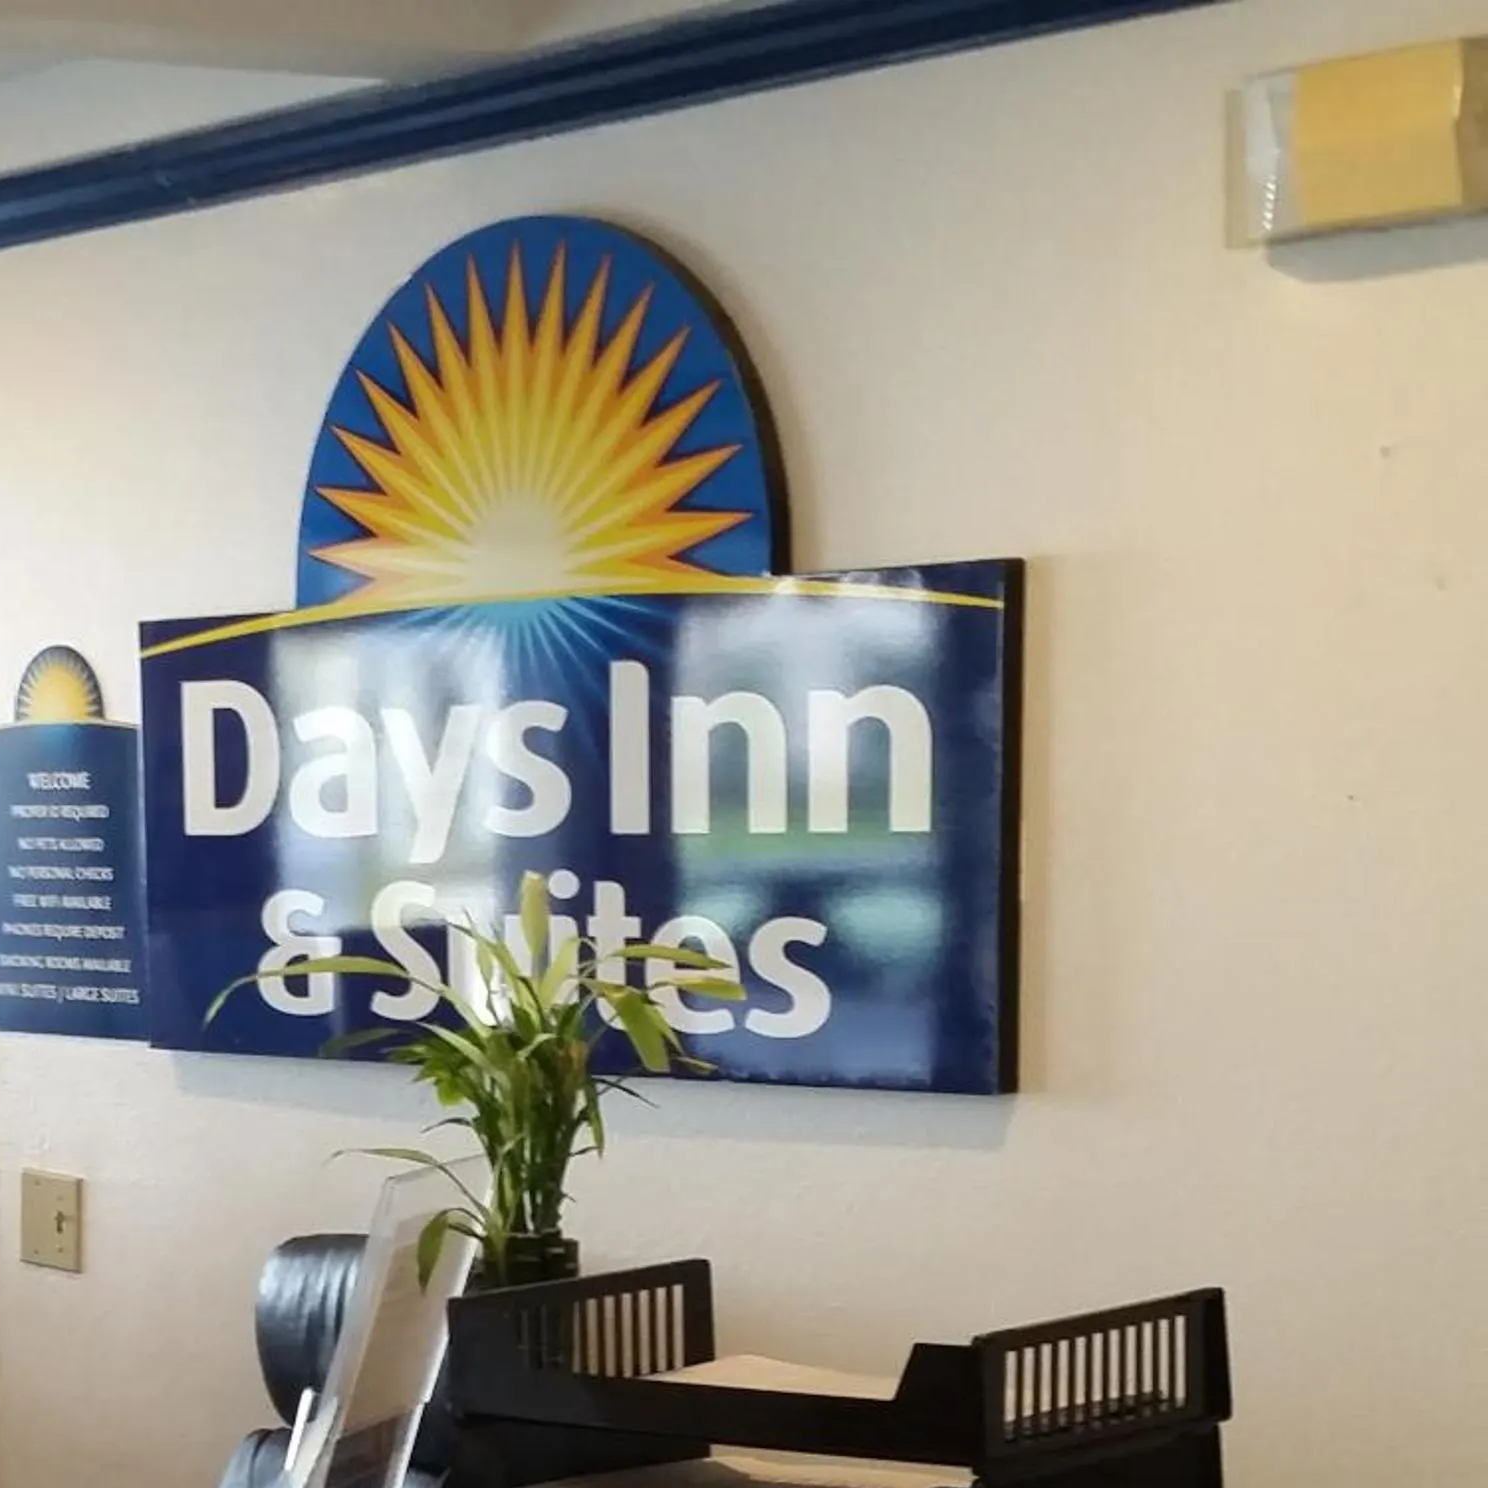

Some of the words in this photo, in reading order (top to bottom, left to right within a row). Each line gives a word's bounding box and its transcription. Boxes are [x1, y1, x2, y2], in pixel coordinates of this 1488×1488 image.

[27, 771, 91, 790] WELCOME
[180, 678, 573, 864] Days
[608, 659, 932, 836] Inn
[257, 888, 341, 1016] &
[369, 869, 832, 1039] Suites
